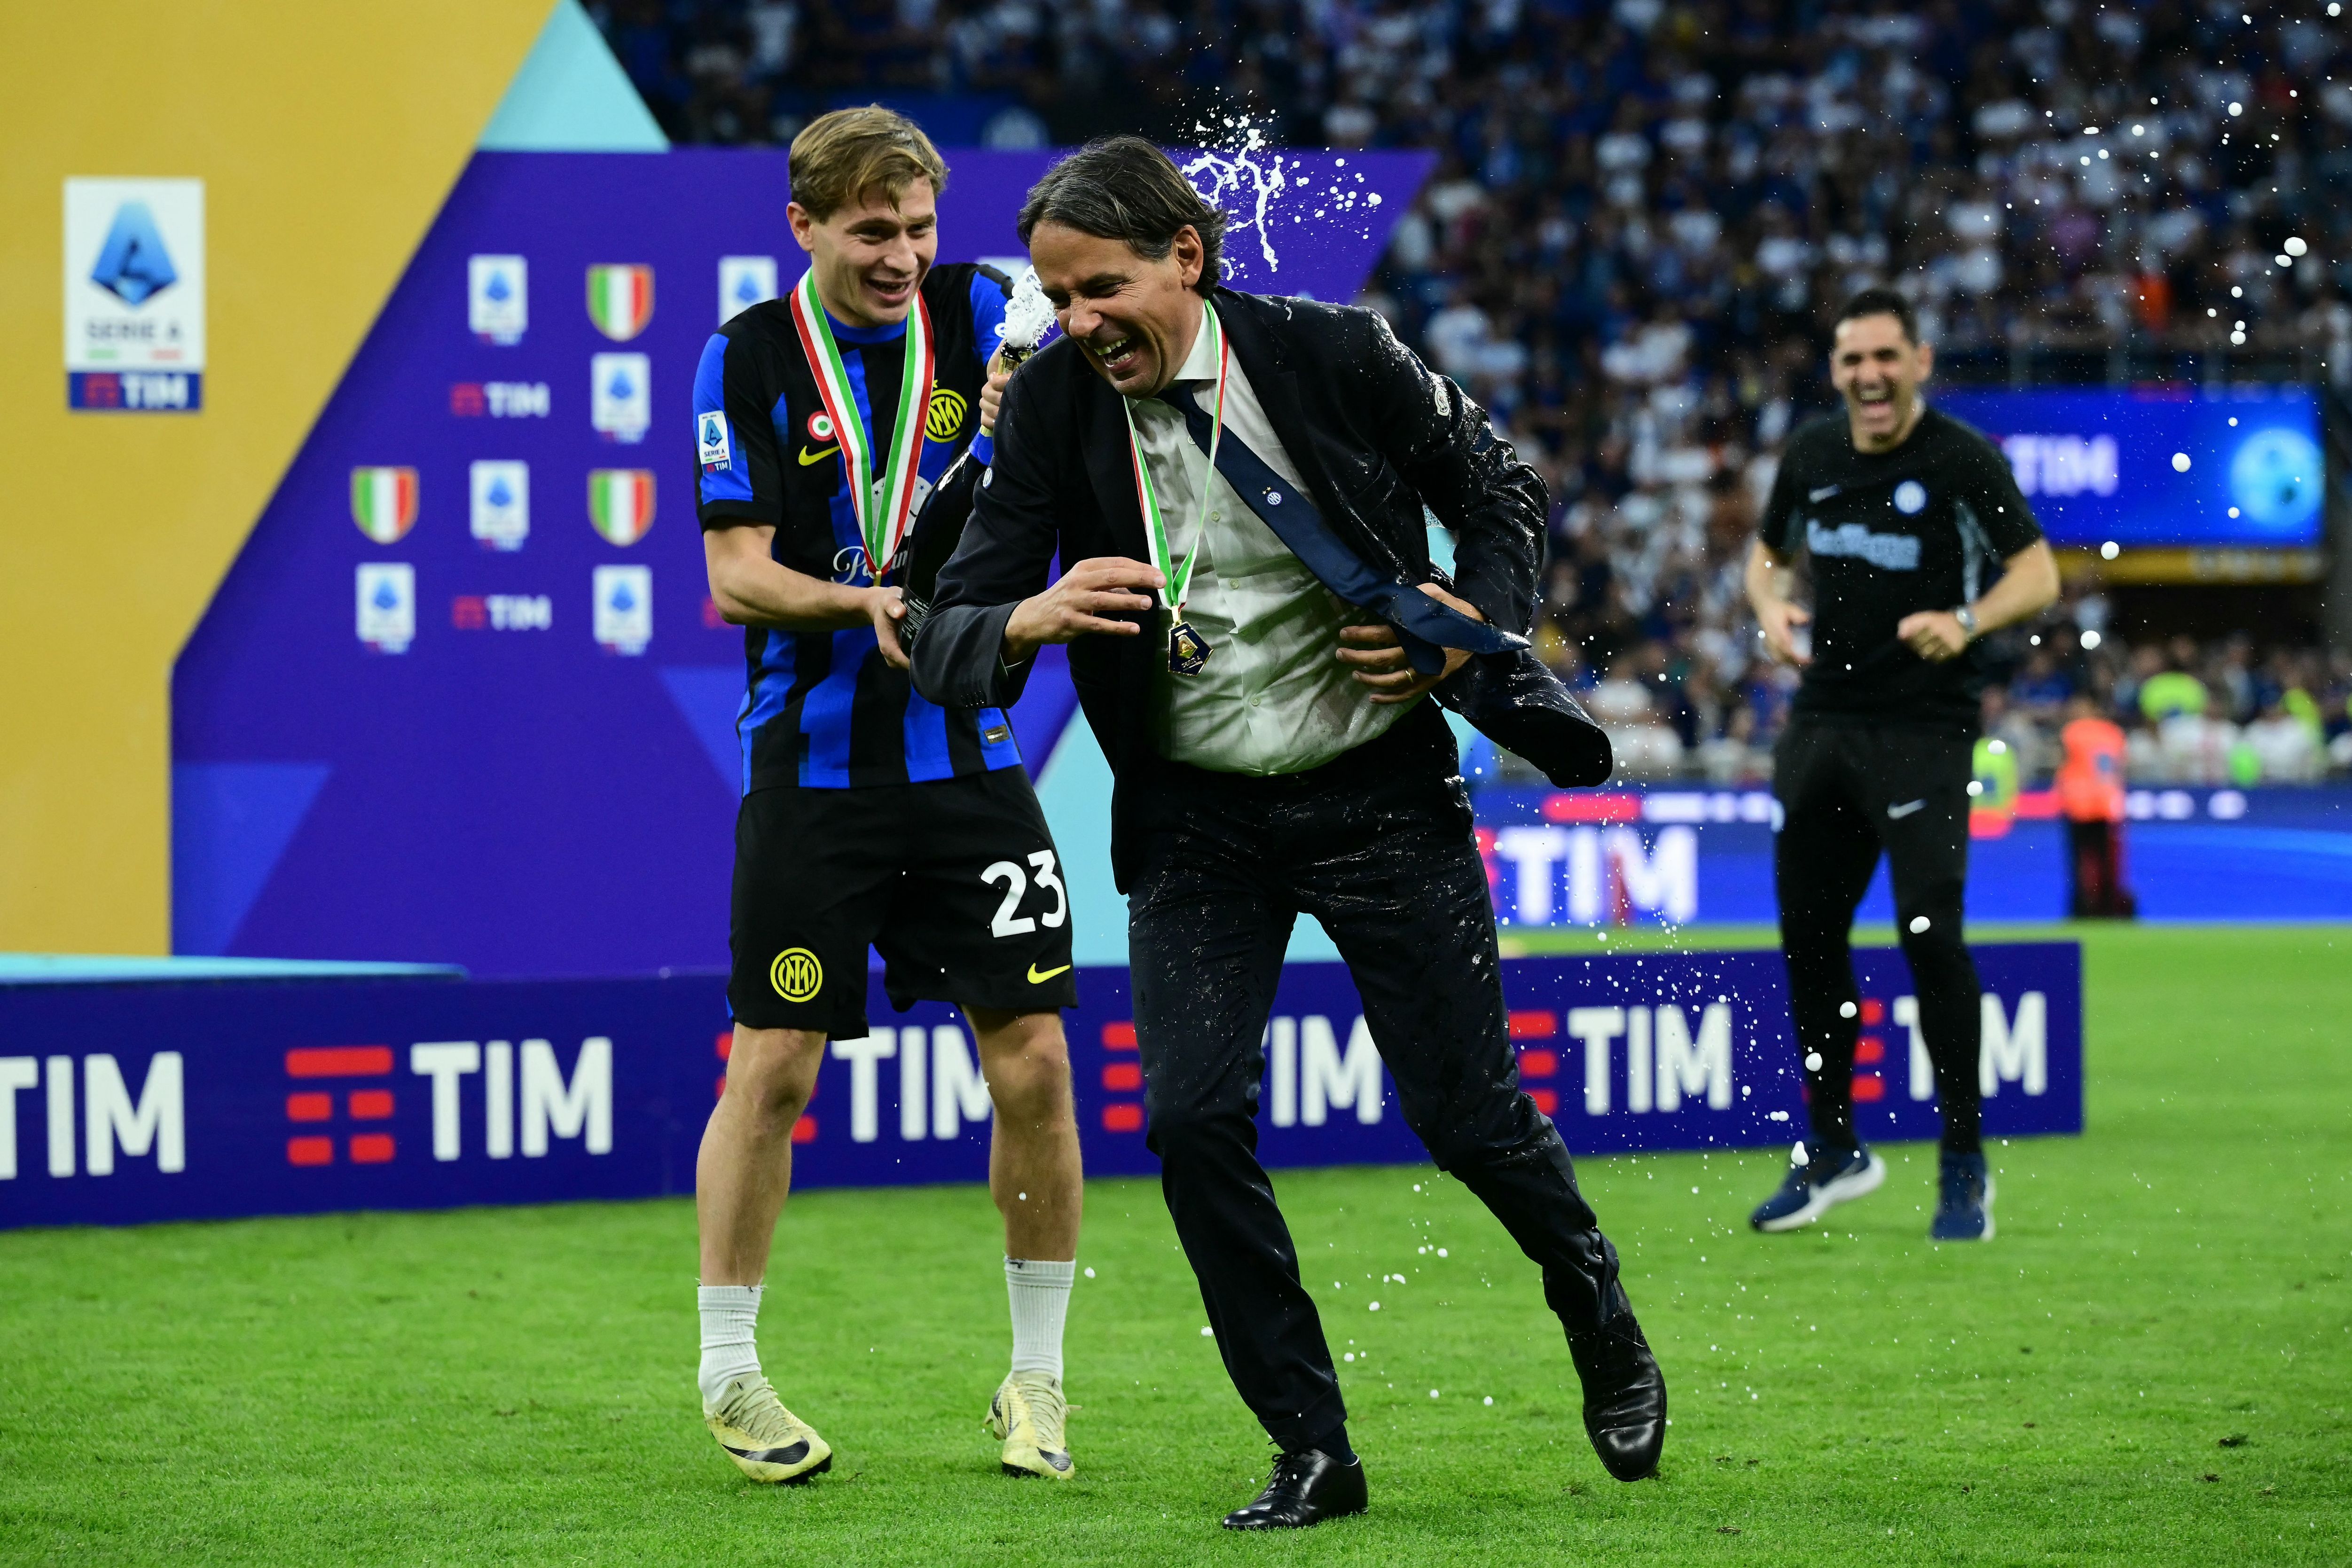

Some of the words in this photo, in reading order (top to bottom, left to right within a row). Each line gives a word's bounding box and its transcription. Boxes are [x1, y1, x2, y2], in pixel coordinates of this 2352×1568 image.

[484, 382, 549, 417] TIM
[715, 462, 728, 470] TIM
[2002, 435, 2118, 496] TIM
[486, 595, 552, 630] TIM
[980, 849, 1066, 937] 23
[1498, 825, 1698, 924] TIM
[1261, 1014, 1382, 1127] IM
[1568, 1003, 1732, 1115] TIM
[1893, 991, 2046, 1100] TM
[410, 1036, 612, 1160] TIM
